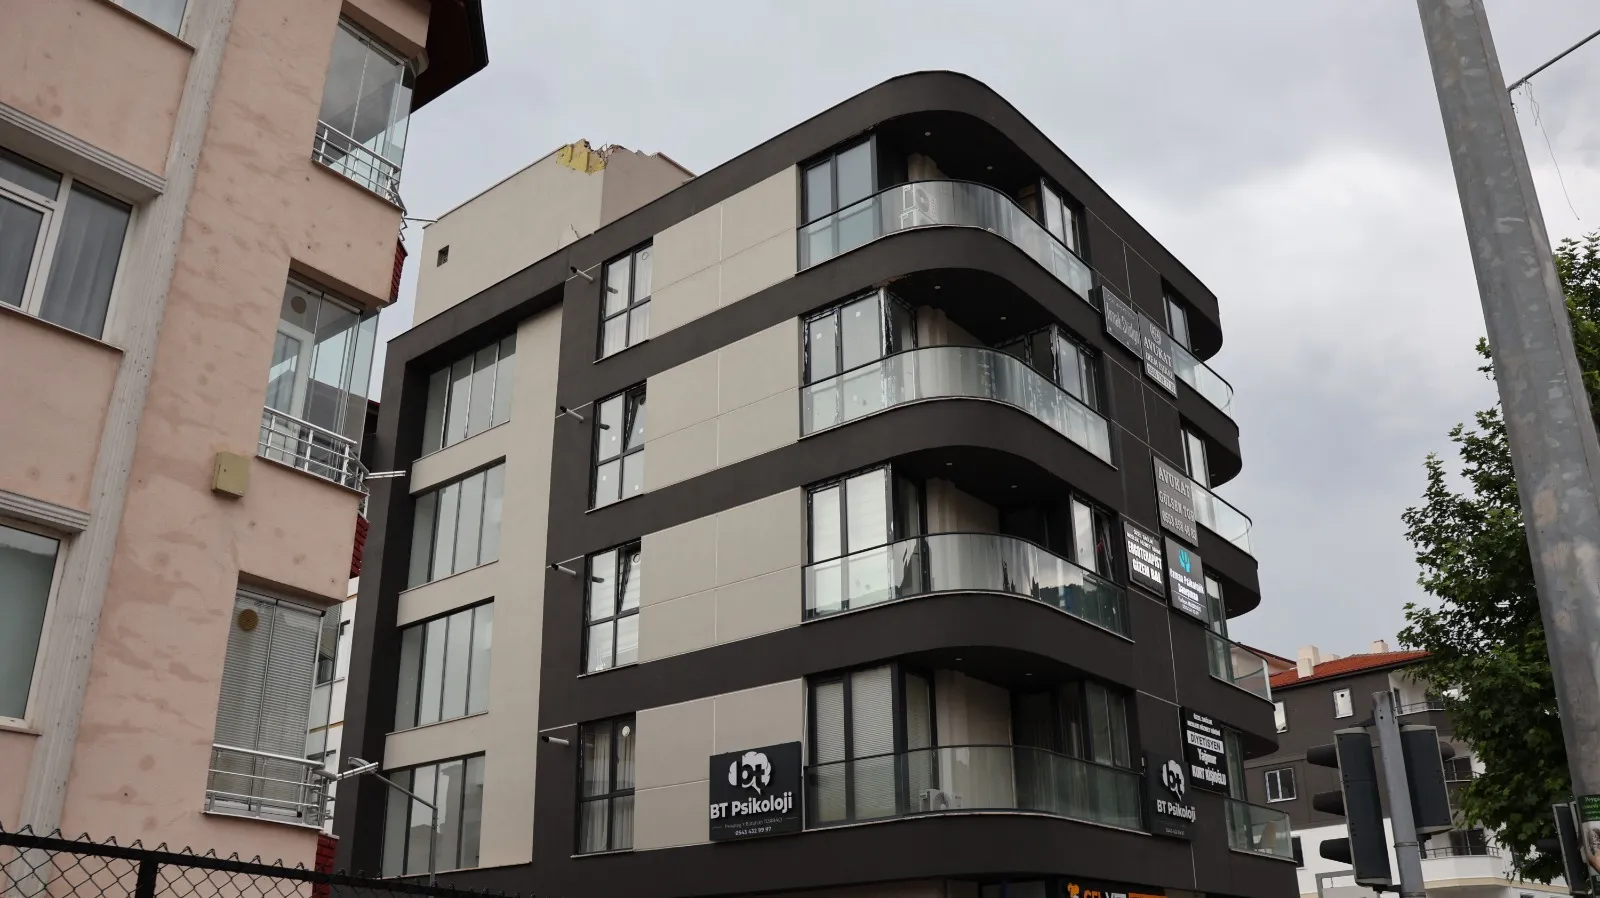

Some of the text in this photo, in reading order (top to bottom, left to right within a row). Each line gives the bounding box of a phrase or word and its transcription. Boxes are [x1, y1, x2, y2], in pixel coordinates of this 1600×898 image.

[1144, 336, 1171, 368] AVUKAT
[1158, 466, 1191, 499] AVUKAT
[1190, 732, 1221, 750] DİYETİSYEN
[710, 791, 793, 819] BT Psikoloji
[1156, 799, 1167, 813] BT
[1167, 801, 1197, 823] Psikoloji
